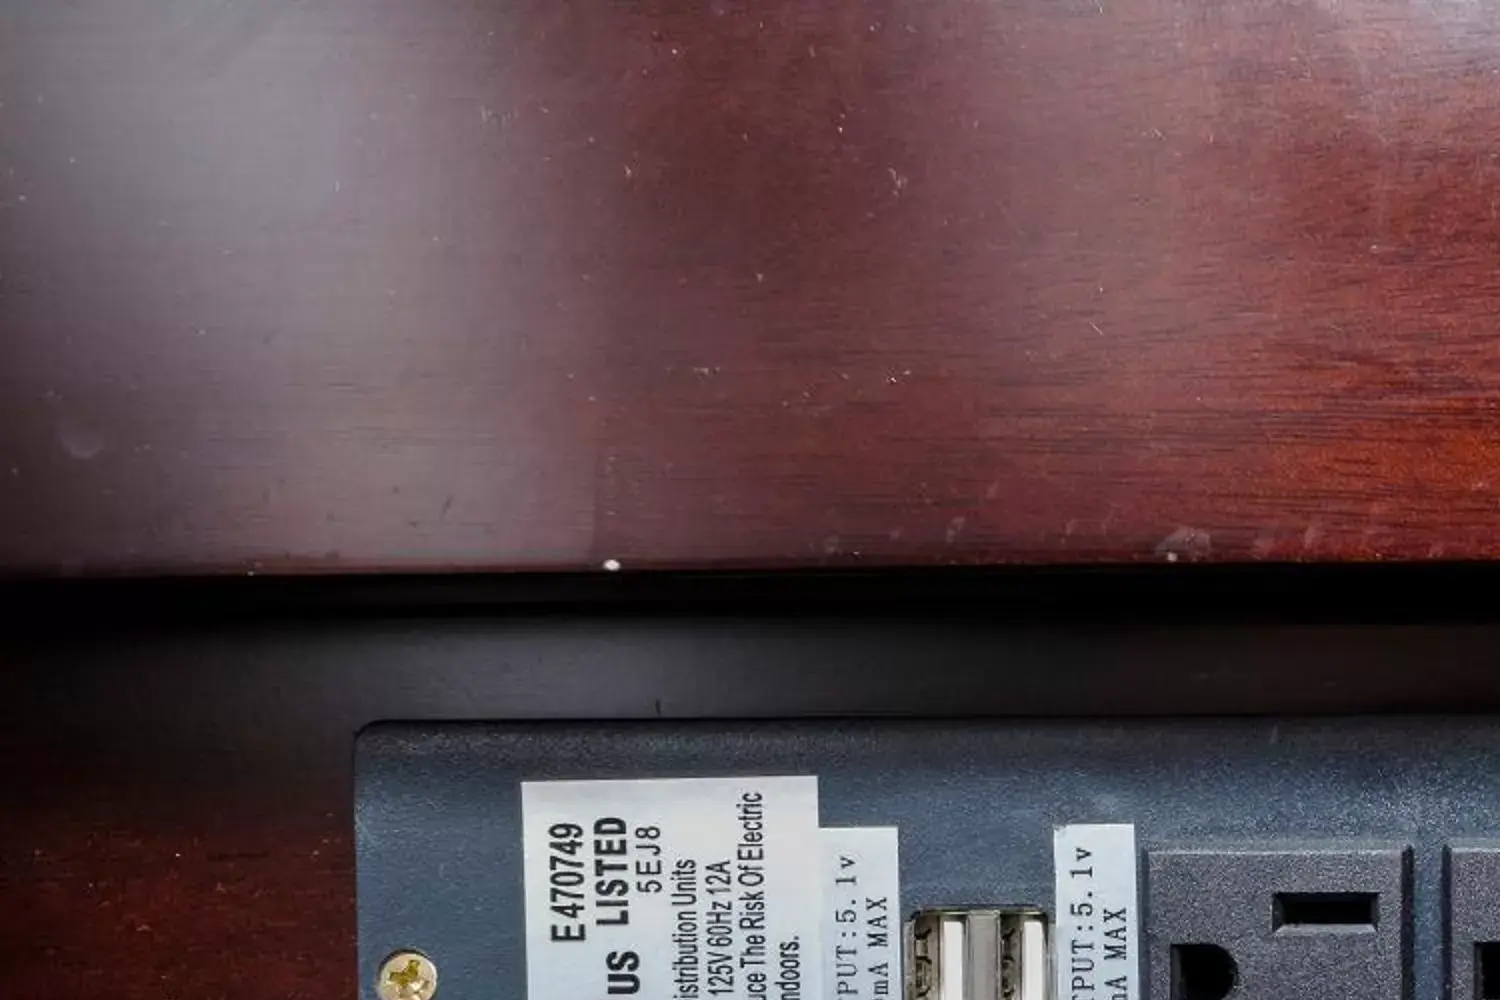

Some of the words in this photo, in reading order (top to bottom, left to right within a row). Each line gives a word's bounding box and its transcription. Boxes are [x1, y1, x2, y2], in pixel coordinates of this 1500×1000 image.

[736, 791, 765, 861] Electric
[593, 816, 630, 926] LISTED
[670, 859, 698, 906] Units
[704, 859, 732, 896] 12A
[737, 864, 765, 887] Of
[706, 900, 734, 947] 60Hz
[738, 890, 766, 931] Risk
[865, 896, 889, 948] MAX
[739, 934, 767, 968] The
[1102, 907, 1127, 961] MAX
[606, 950, 641, 995] US
[706, 951, 735, 996] 125V
